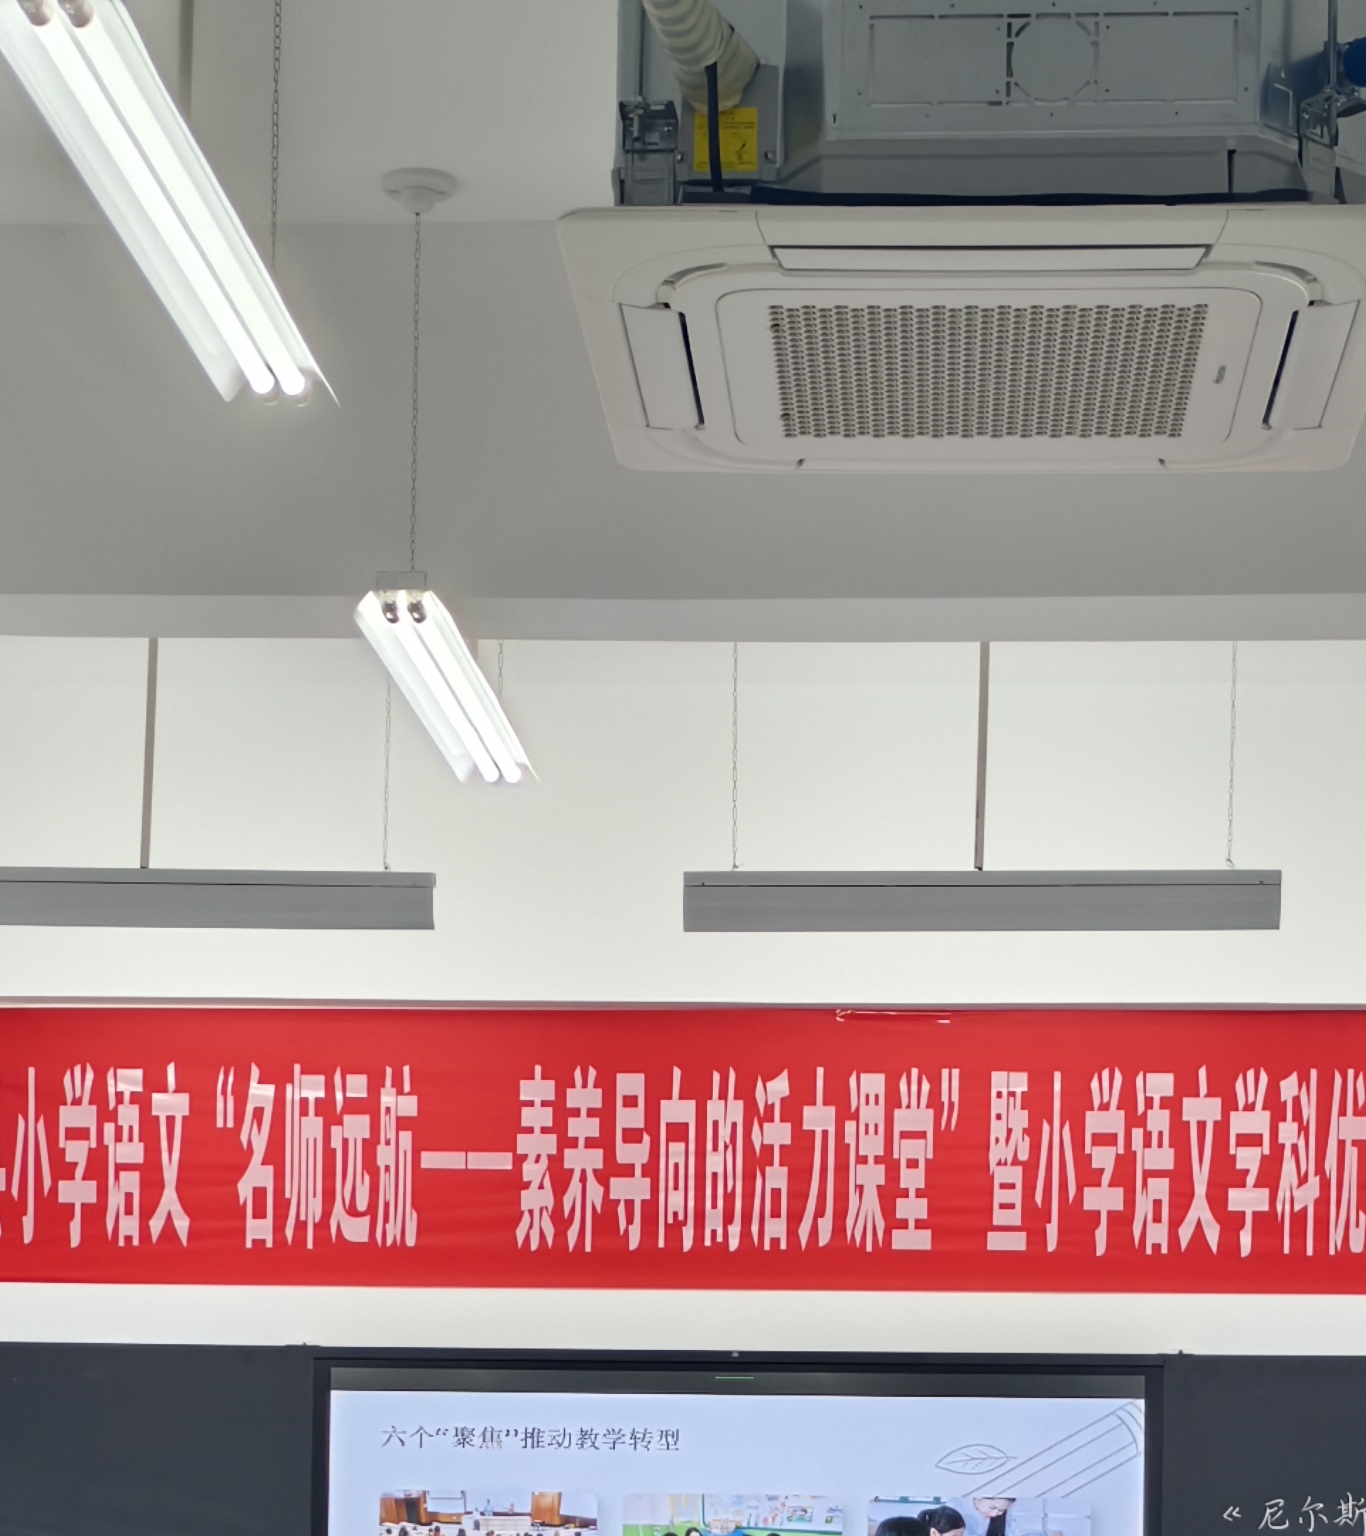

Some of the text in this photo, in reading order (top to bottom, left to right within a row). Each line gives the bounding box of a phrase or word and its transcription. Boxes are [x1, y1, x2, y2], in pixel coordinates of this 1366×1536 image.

[381, 1425, 680, 1451] 六个“聚焦”推动教学转型
